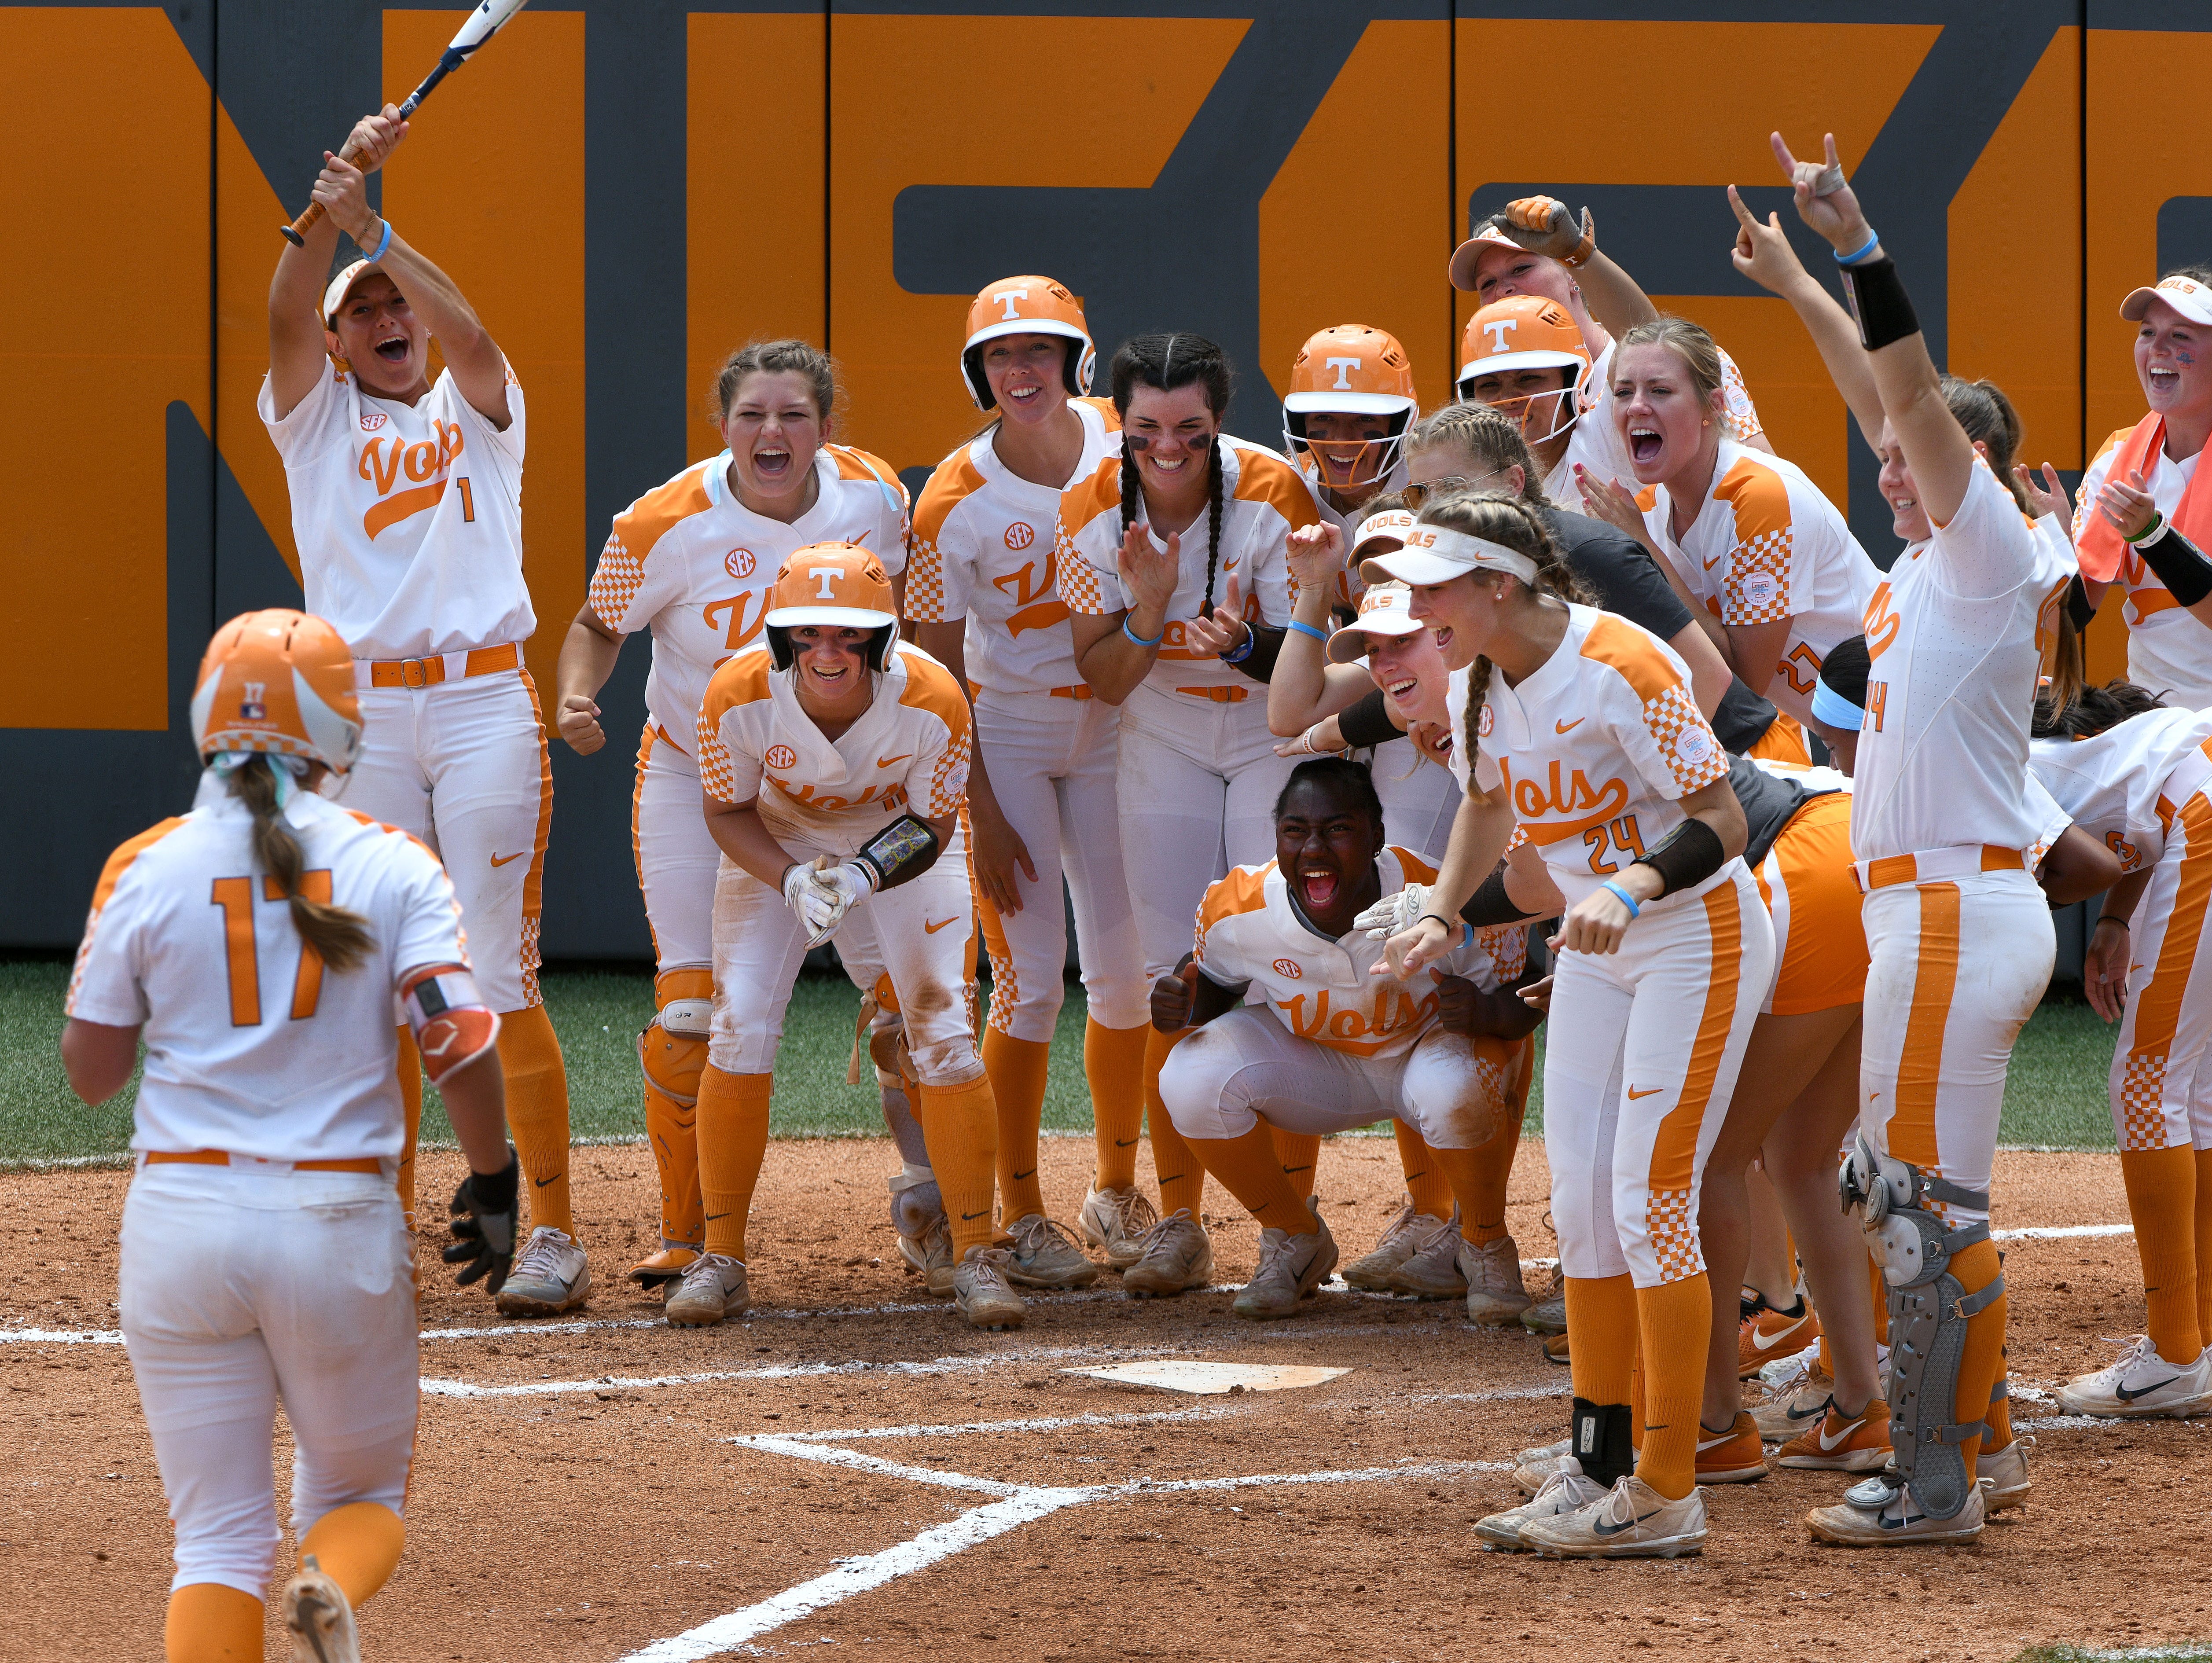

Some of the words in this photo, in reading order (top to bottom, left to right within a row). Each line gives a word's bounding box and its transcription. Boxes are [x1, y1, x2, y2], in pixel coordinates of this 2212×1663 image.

[993, 290, 1028, 320] T
[1483, 319, 1517, 352] T
[1326, 357, 1361, 389] T
[361, 414, 386, 430] SEC
[456, 477, 475, 522] 1
[1006, 523, 1031, 549] SEC
[1367, 515, 1412, 532] VOLS
[727, 550, 754, 577] SEC
[808, 567, 845, 599] T
[1776, 641, 1823, 695] 27
[767, 746, 794, 768] SEC
[1583, 815, 1646, 874] 24
[211, 869, 333, 1027] 17
[1275, 959, 1300, 978] SEC
[1276, 989, 1439, 1039] Vols
